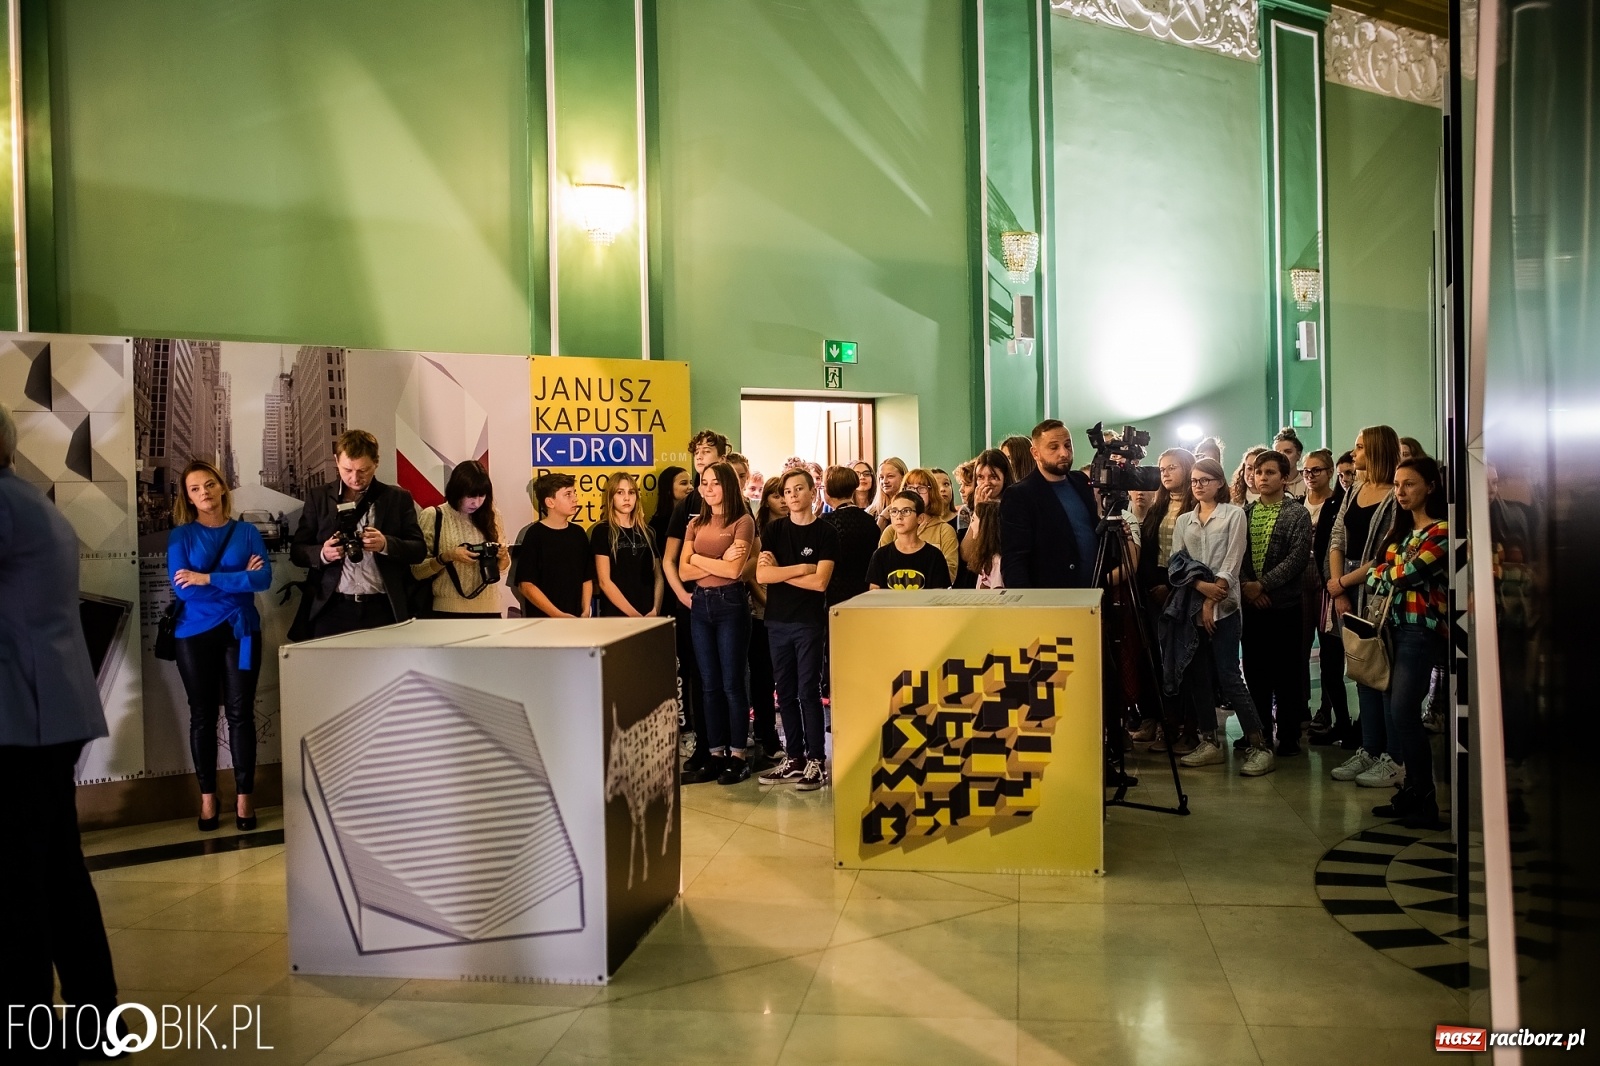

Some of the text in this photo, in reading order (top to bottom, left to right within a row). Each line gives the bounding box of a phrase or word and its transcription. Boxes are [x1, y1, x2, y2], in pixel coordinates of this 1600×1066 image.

[534, 376, 652, 403] JANUSZ
[535, 407, 667, 433] KAPUSTA
[536, 437, 648, 463] K-DRON
[74, 773, 140, 786] RONOWA, 1997
